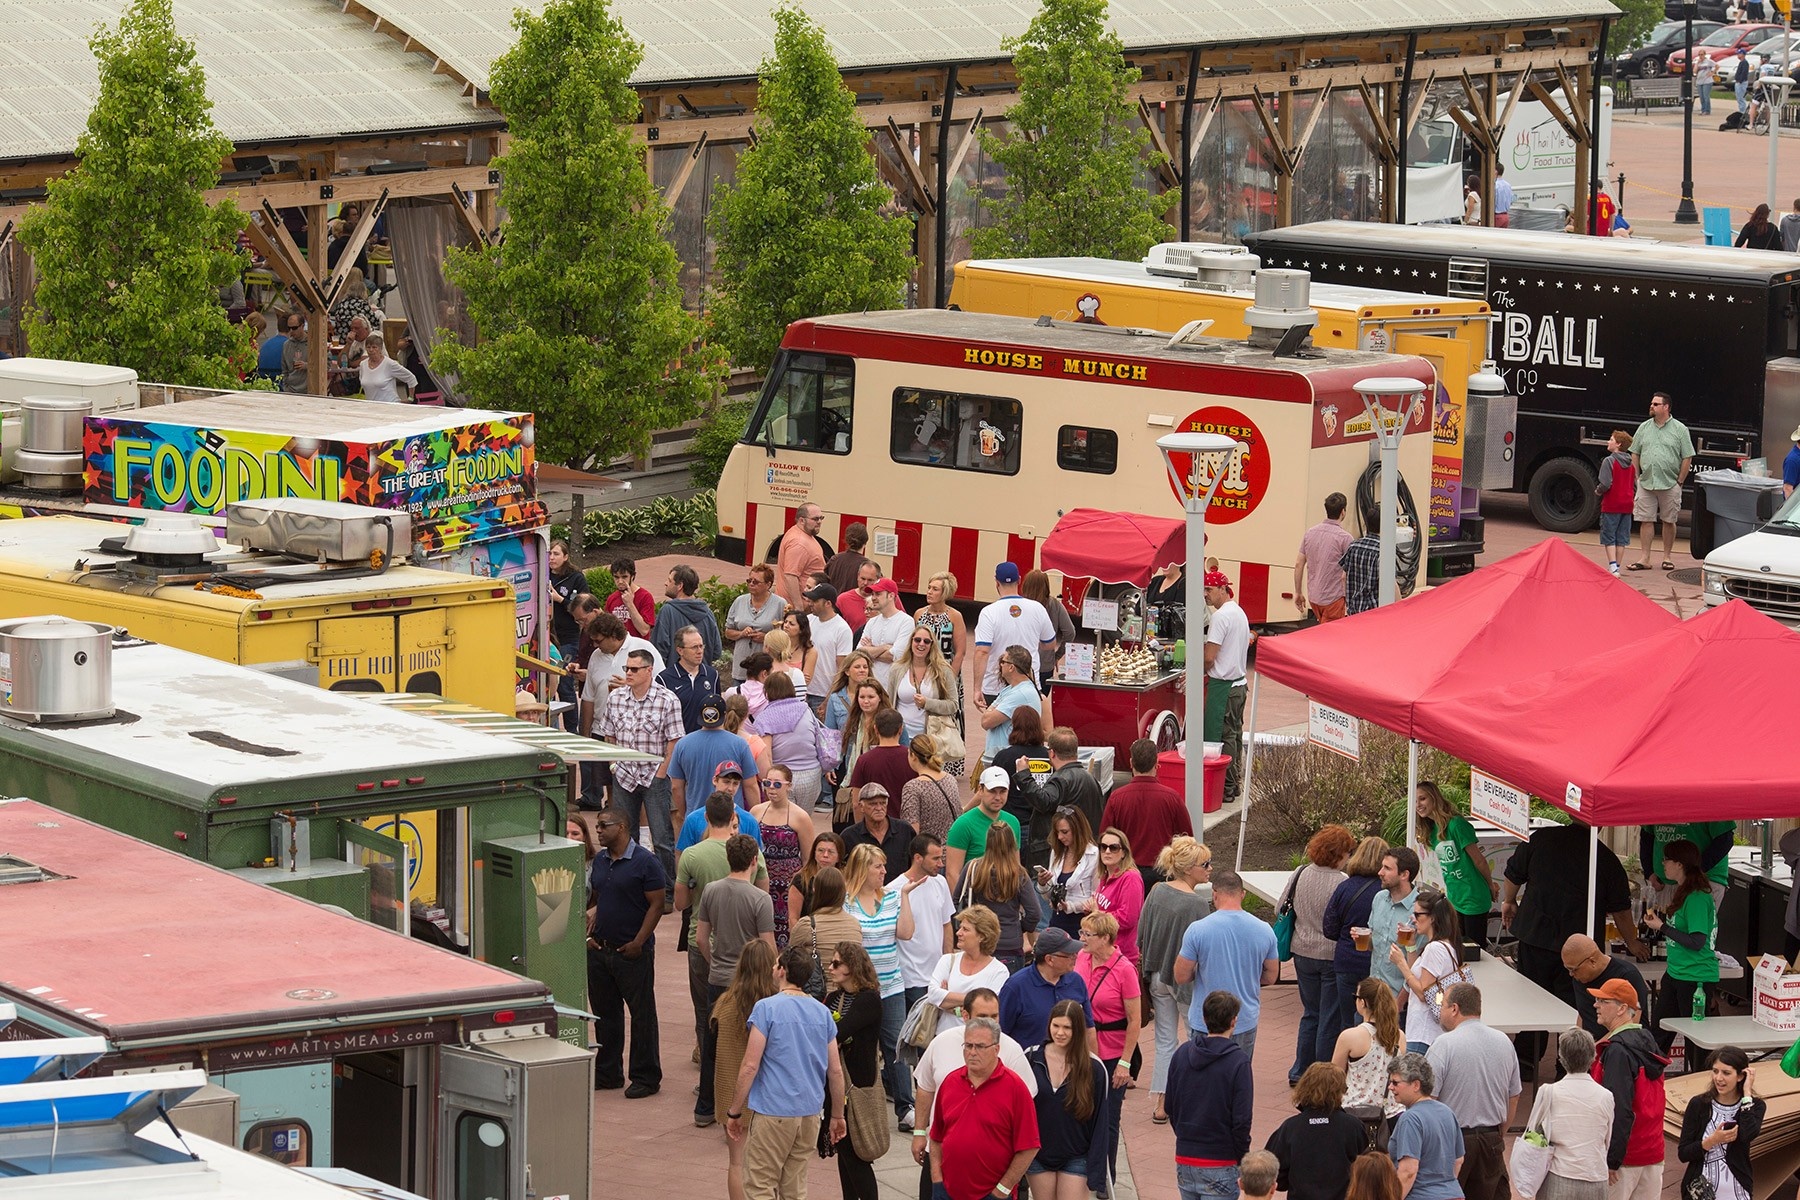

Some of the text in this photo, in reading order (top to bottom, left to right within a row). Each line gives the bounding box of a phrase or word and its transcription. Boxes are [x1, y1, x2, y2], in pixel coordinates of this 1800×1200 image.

[1531, 130, 1549, 150] Thai
[1533, 155, 1575, 167] Food Truck
[1601, 203, 1609, 219] 6
[1492, 290, 1516, 309] The
[1489, 311, 1605, 369] TBALL
[964, 348, 1043, 370] HOUSE
[1063, 357, 1148, 381] MUNCH
[1190, 421, 1253, 438] HOUSE
[1345, 420, 1372, 434] HOUSE
[114, 438, 341, 508] FOODINI
[382, 447, 523, 495] THE GREAT FOODINI
[768, 462, 799, 471] FOLLOW
[427, 484, 522, 509] www.greatfoodinifoodtruck.com
[1185, 493, 1249, 510] NCH
[327, 656, 358, 677] EAT
[409, 648, 441, 672] DOGS
[1319, 707, 1350, 728] BEVERAGES
[1324, 723, 1334, 735] Cash
[1335, 727, 1345, 741] Only
[1483, 780, 1518, 805] BEVERAGES
[1488, 797, 1500, 811] Cash
[1501, 803, 1512, 818] Only
[1656, 833, 1687, 842] SQUARE
[1761, 995, 1778, 1009] LUCKY
[559, 1027, 579, 1037] FOOD
[1779, 1022, 1797, 1030] STAR
